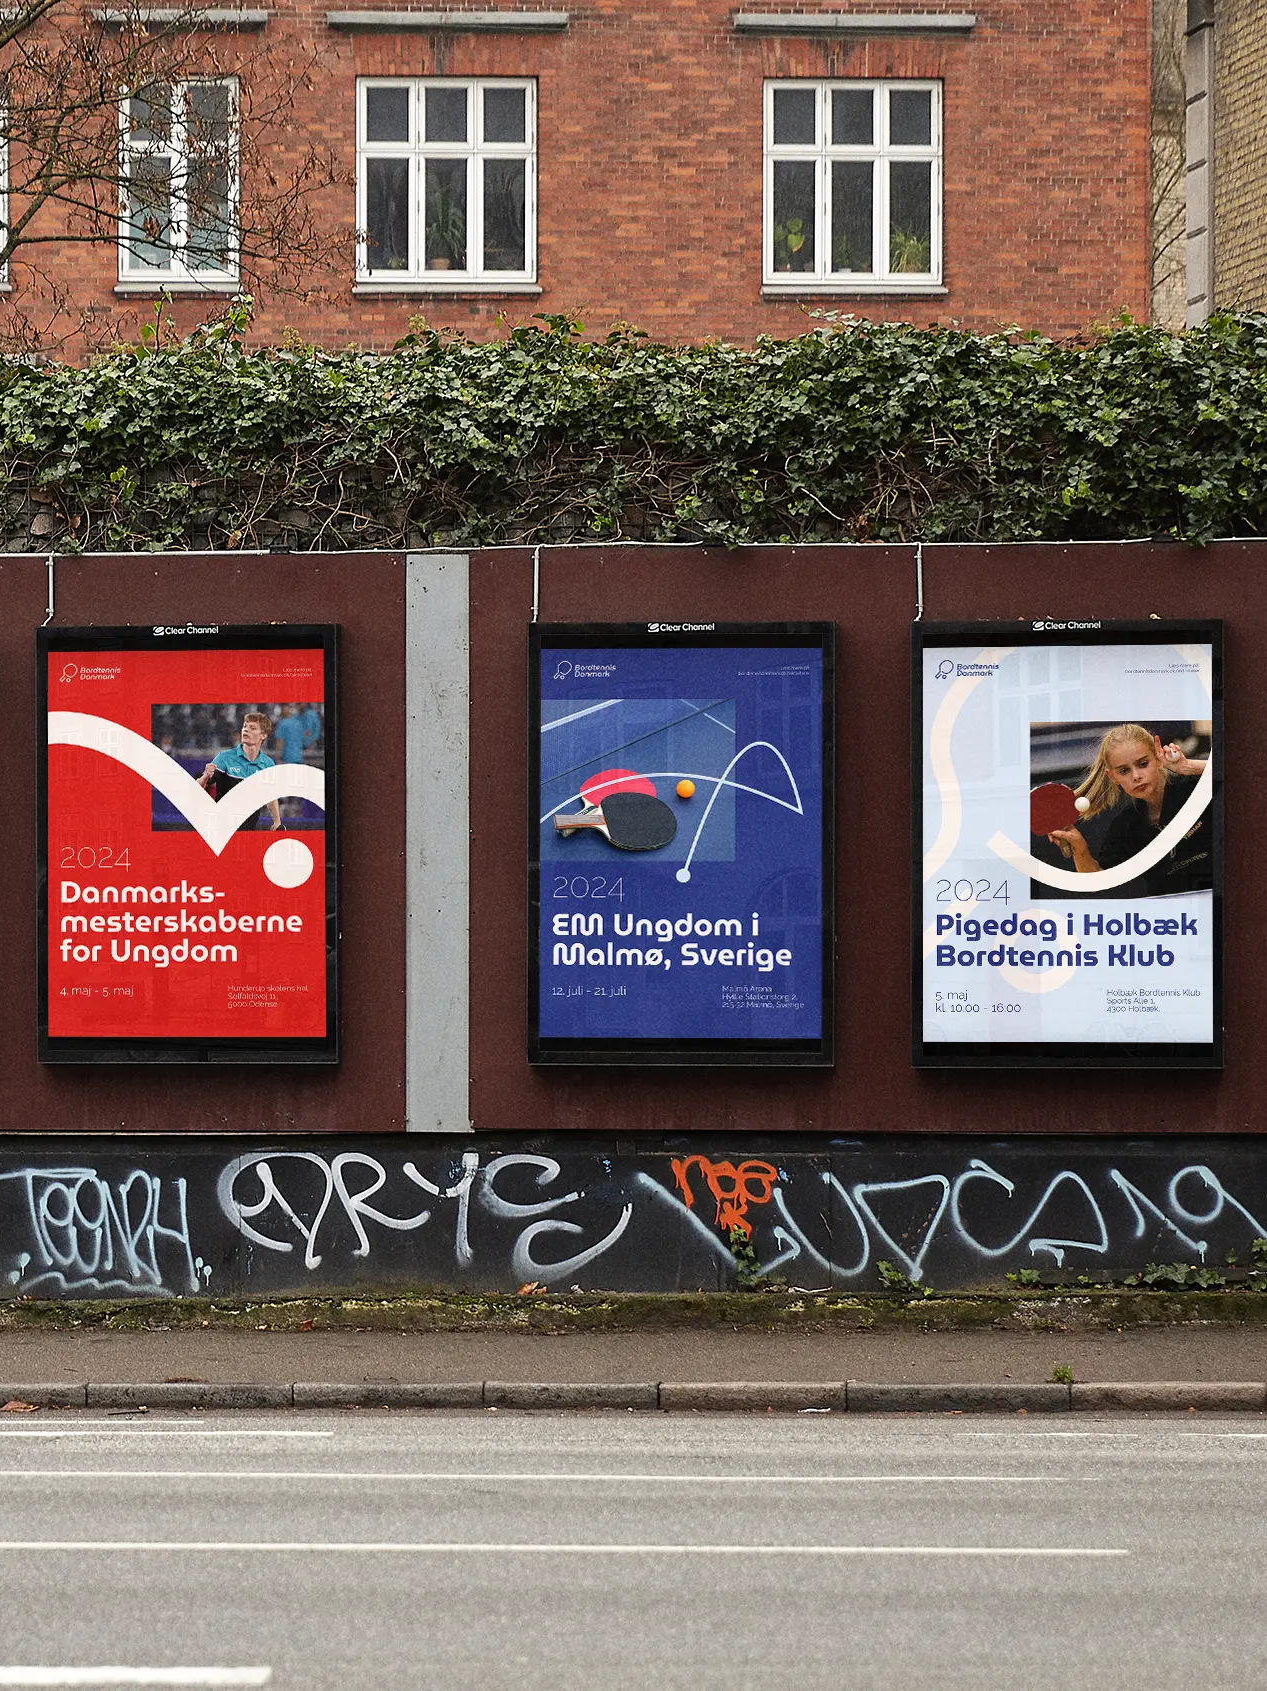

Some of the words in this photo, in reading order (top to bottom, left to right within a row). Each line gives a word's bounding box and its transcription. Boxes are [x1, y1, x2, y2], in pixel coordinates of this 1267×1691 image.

[164, 626, 187, 635] Clear
[186, 625, 219, 635] Channel
[659, 623, 682, 632] Clear
[681, 622, 715, 632] Channel
[1044, 621, 1067, 630] Clear
[1067, 620, 1102, 630] Channel
[79, 666, 121, 675] Bordtennis
[574, 663, 617, 673] Bordtennis
[574, 670, 611, 678] Danmark
[956, 663, 1000, 672] Bordtennis
[956, 669, 994, 677] Danmark
[79, 672, 115, 681] Danmark
[60, 846, 132, 873] 2024
[60, 879, 226, 904] Danmarks-
[552, 875, 625, 903] 2024
[936, 878, 1011, 906] 2024
[60, 908, 303, 933] mesterskaberne
[552, 912, 604, 937] EM
[613, 912, 743, 942] Ungdom
[751, 911, 760, 937] i
[936, 912, 1058, 942] Pigedag
[1066, 912, 1074, 936] i
[1083, 912, 1198, 937] Holbæk
[59, 938, 103, 963] for
[110, 938, 238, 968] Ungdom
[552, 940, 672, 971] Malmø,
[680, 941, 793, 972] Sverige
[936, 942, 1099, 967] Bordtennis
[1108, 943, 1175, 967] Klub
[71, 985, 92, 998] maj
[113, 985, 134, 998] maj
[227, 984, 266, 993] Hunderup
[266, 984, 296, 993] skolens
[566, 985, 584, 998] juli
[608, 985, 627, 998] juli
[1106, 988, 1138, 997] Holbæk
[1139, 988, 1182, 997] Bordtennis
[1182, 988, 1201, 997] Klub
[947, 989, 968, 1002] maj
[227, 1001, 248, 1009] 5000
[248, 999, 279, 1008] Odense
